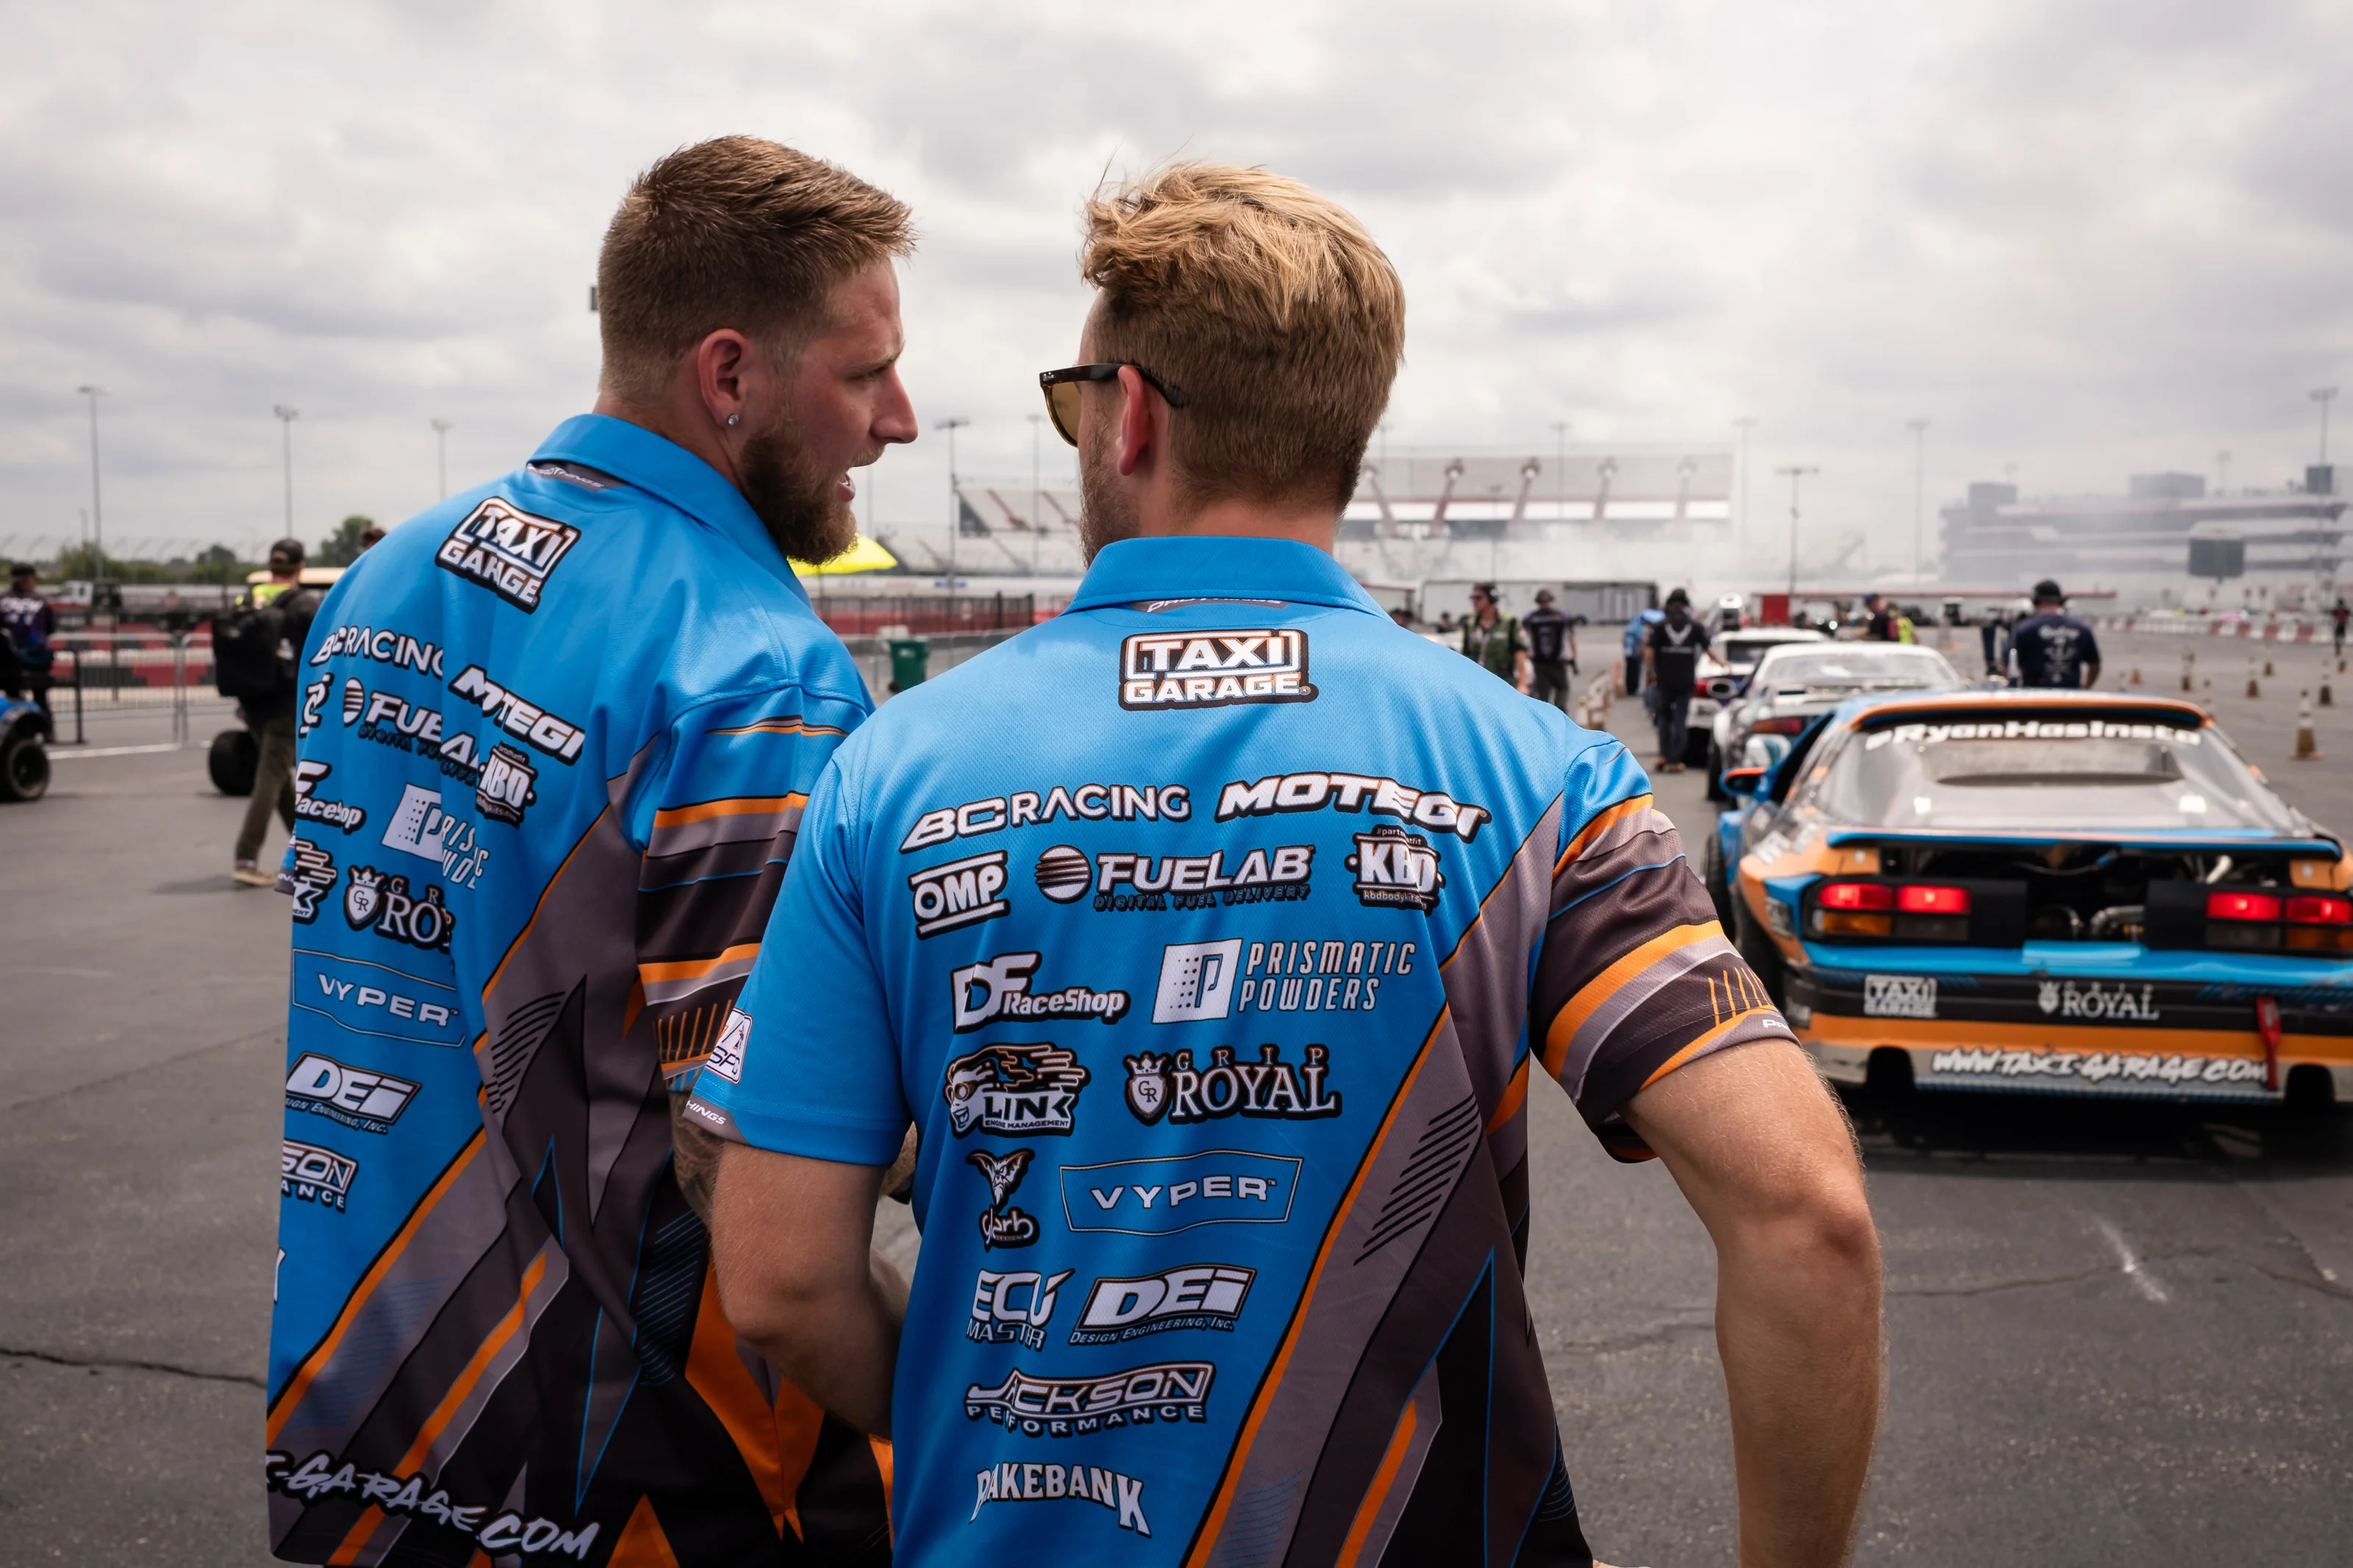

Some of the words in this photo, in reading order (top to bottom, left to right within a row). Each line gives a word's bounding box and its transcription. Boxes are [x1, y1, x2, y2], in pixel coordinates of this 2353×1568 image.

[478, 506, 563, 568] TAXI
[1140, 637, 1285, 671] TAXI
[1124, 671, 1302, 704] GARAGE
[1218, 773, 1480, 837] MOTEGI
[1097, 846, 1310, 891] FUELAB
[1360, 842, 1435, 892] KBD
[915, 863, 1003, 919] OMP
[1225, 884, 1310, 903] DELIVERY
[1246, 942, 1415, 975] PRISMATIC
[1239, 978, 1379, 1012] POWDERS
[2061, 991, 2160, 1020] ROYAL
[984, 1092, 1074, 1121] LINK
[1172, 1065, 1335, 1117] ROYAL
